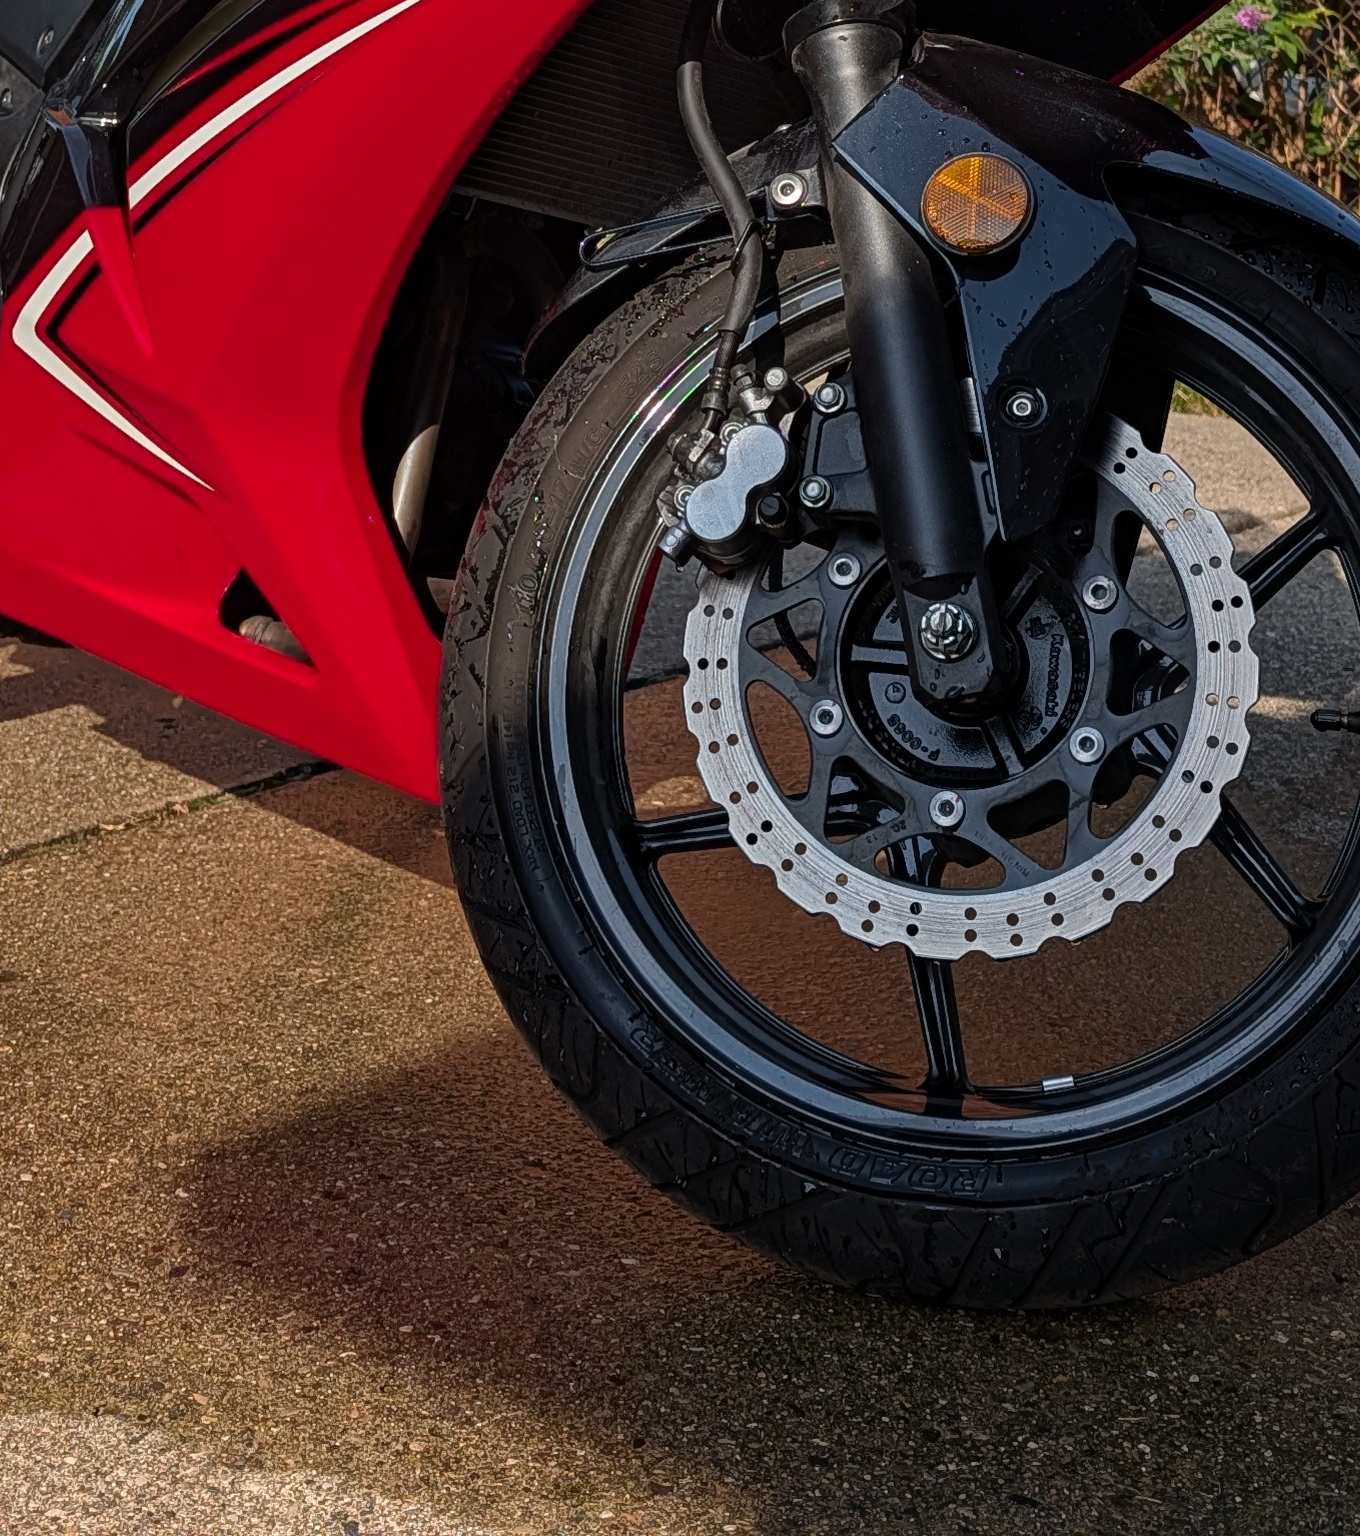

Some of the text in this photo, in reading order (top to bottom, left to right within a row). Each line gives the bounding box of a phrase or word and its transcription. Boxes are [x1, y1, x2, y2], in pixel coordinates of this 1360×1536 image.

[618, 349, 664, 398] 54S
[1045, 634, 1064, 717] Kawasaki
[503, 741, 517, 760] kg
[887, 713, 941, 762] F-0065
[505, 765, 520, 794] 212
[517, 771, 533, 801] kPa
[512, 800, 530, 837] LOAD
[828, 1146, 987, 1195] ROAD
